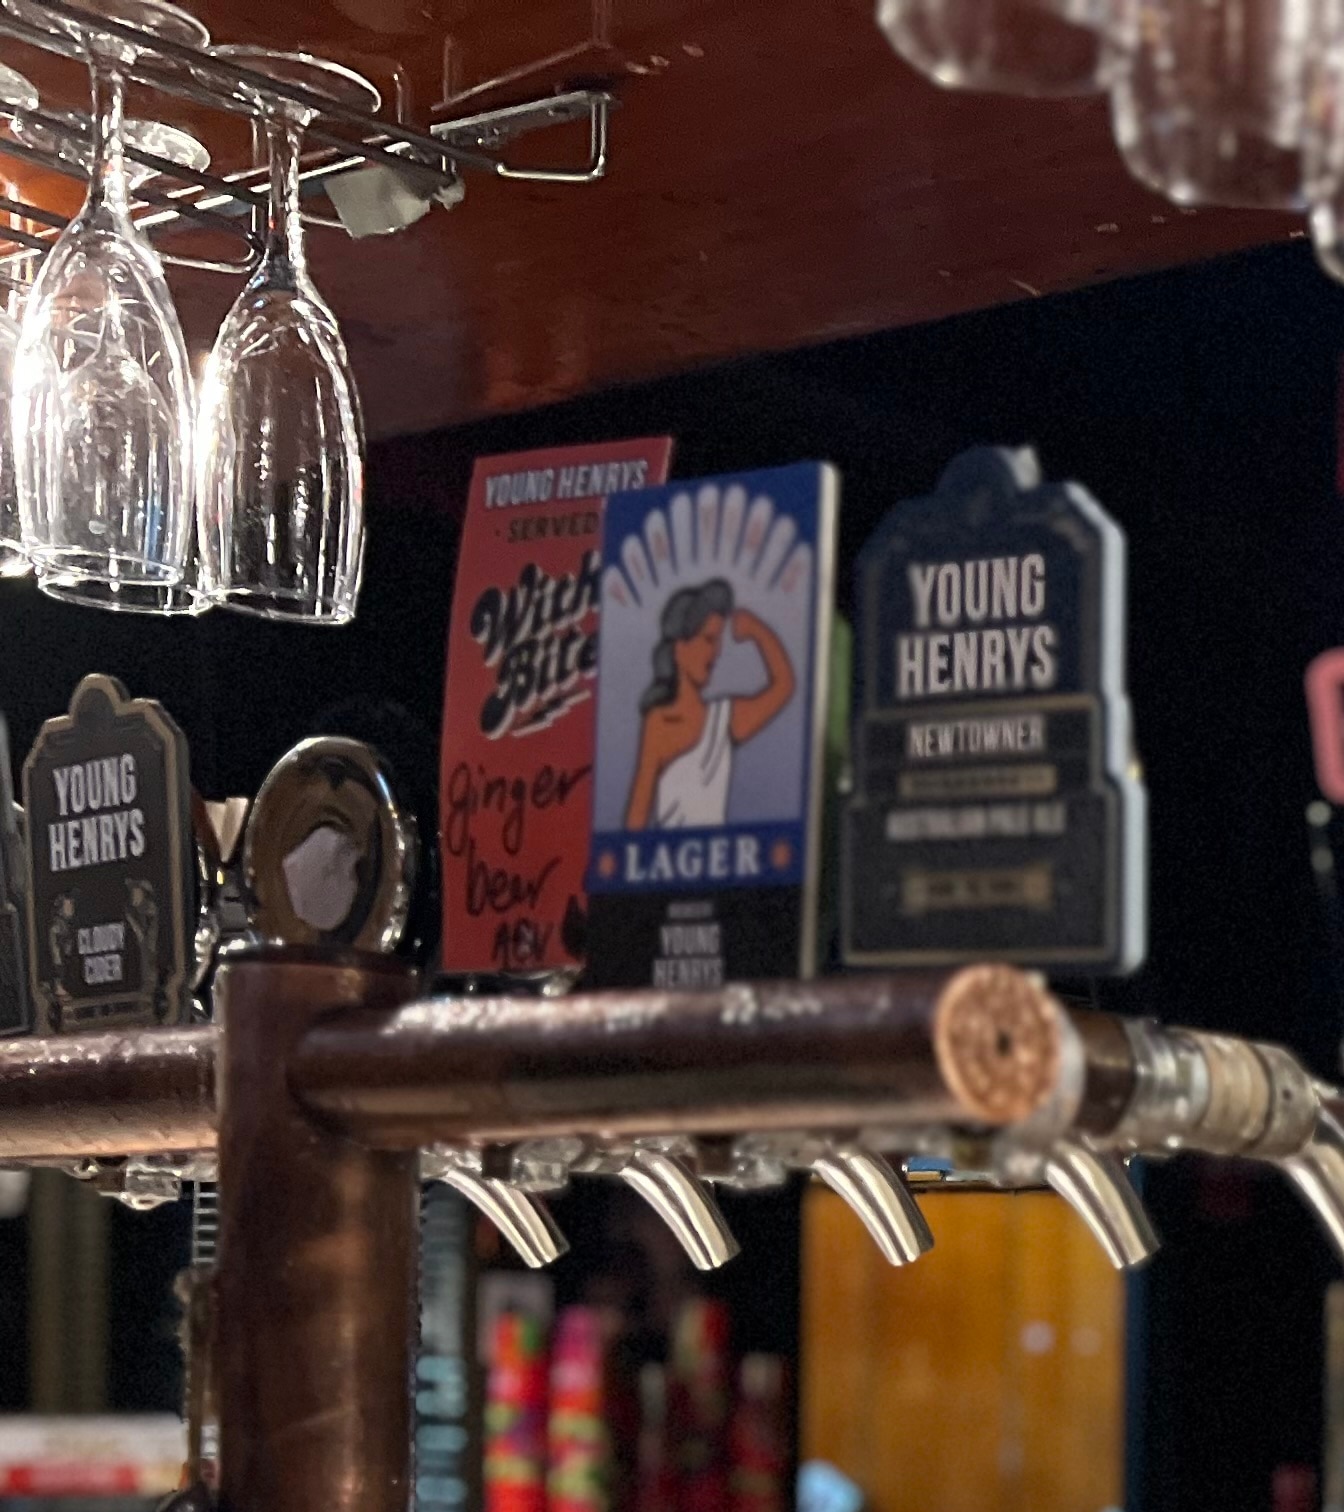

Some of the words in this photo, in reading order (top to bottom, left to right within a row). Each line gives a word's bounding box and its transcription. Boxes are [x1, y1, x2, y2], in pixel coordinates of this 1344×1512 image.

[485, 468, 554, 509] YOUNG
[556, 460, 648, 499] HENRYS
[908, 552, 1047, 629] YOUNG
[897, 625, 1057, 698] HENRYS
[910, 713, 1045, 759] NEWTOWNER
[52, 753, 137, 817] YOUNG
[48, 808, 145, 872] HENRYS
[625, 836, 761, 882] LAGER
